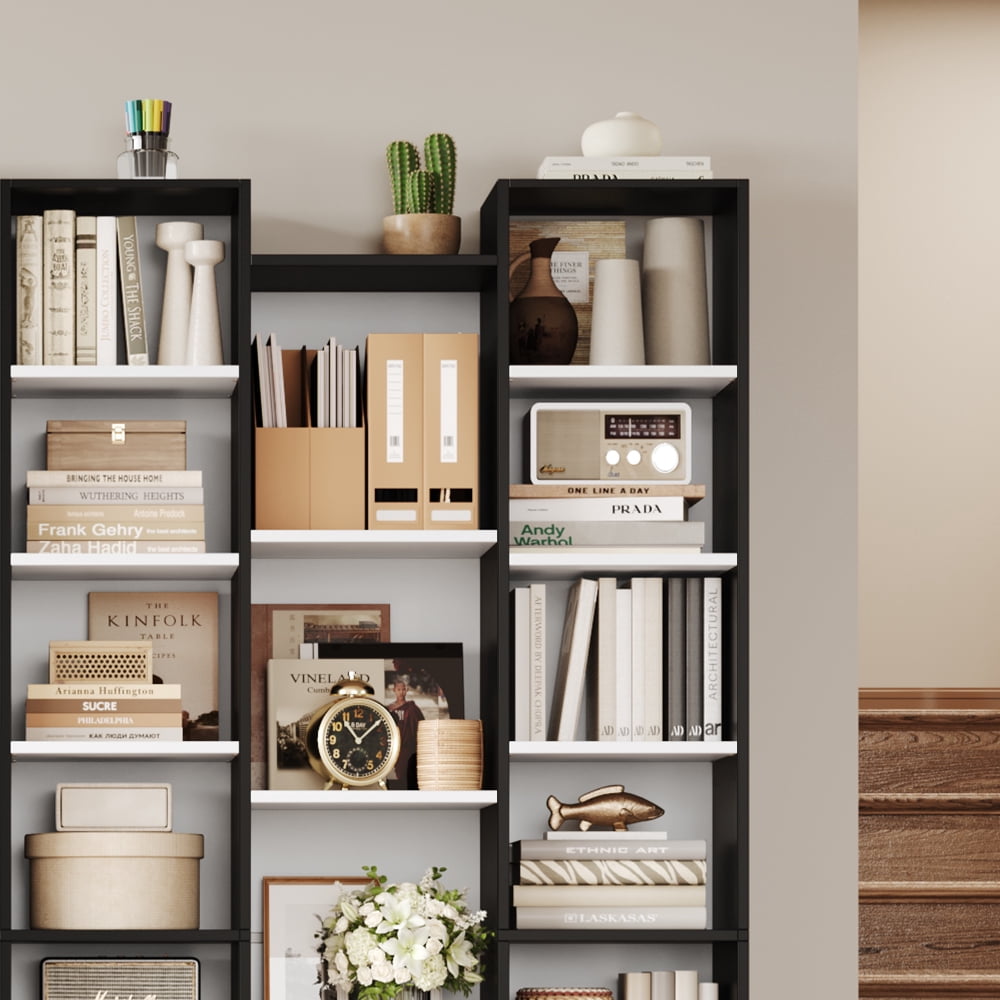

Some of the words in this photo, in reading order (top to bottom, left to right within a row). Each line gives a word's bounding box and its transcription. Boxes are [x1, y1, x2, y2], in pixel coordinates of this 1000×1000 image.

[122, 234, 135, 273] YOUNG
[125, 283, 140, 305] THE
[129, 306, 142, 341] SHACK
[67, 474, 100, 482] BRINGING
[79, 492, 138, 500] WUTHERING
[144, 492, 184, 500] HEIGHTS
[612, 504, 662, 514] PRADA
[38, 523, 86, 536] Frank
[92, 523, 143, 539] Gehry
[521, 524, 565, 538] Andy
[39, 541, 81, 553] Zaha
[88, 541, 137, 553] Hadid
[108, 615, 203, 627] KINFOLK
[708, 588, 719, 700] ARCHITECTURAL
[56, 687, 95, 695] Arianna
[99, 687, 154, 696] Huffington
[82, 701, 117, 711] SUCRE
[671, 725, 684, 736] AD
[689, 725, 702, 736] AD
[705, 722, 721, 735] ar
[579, 914, 656, 923] LASKASAS
